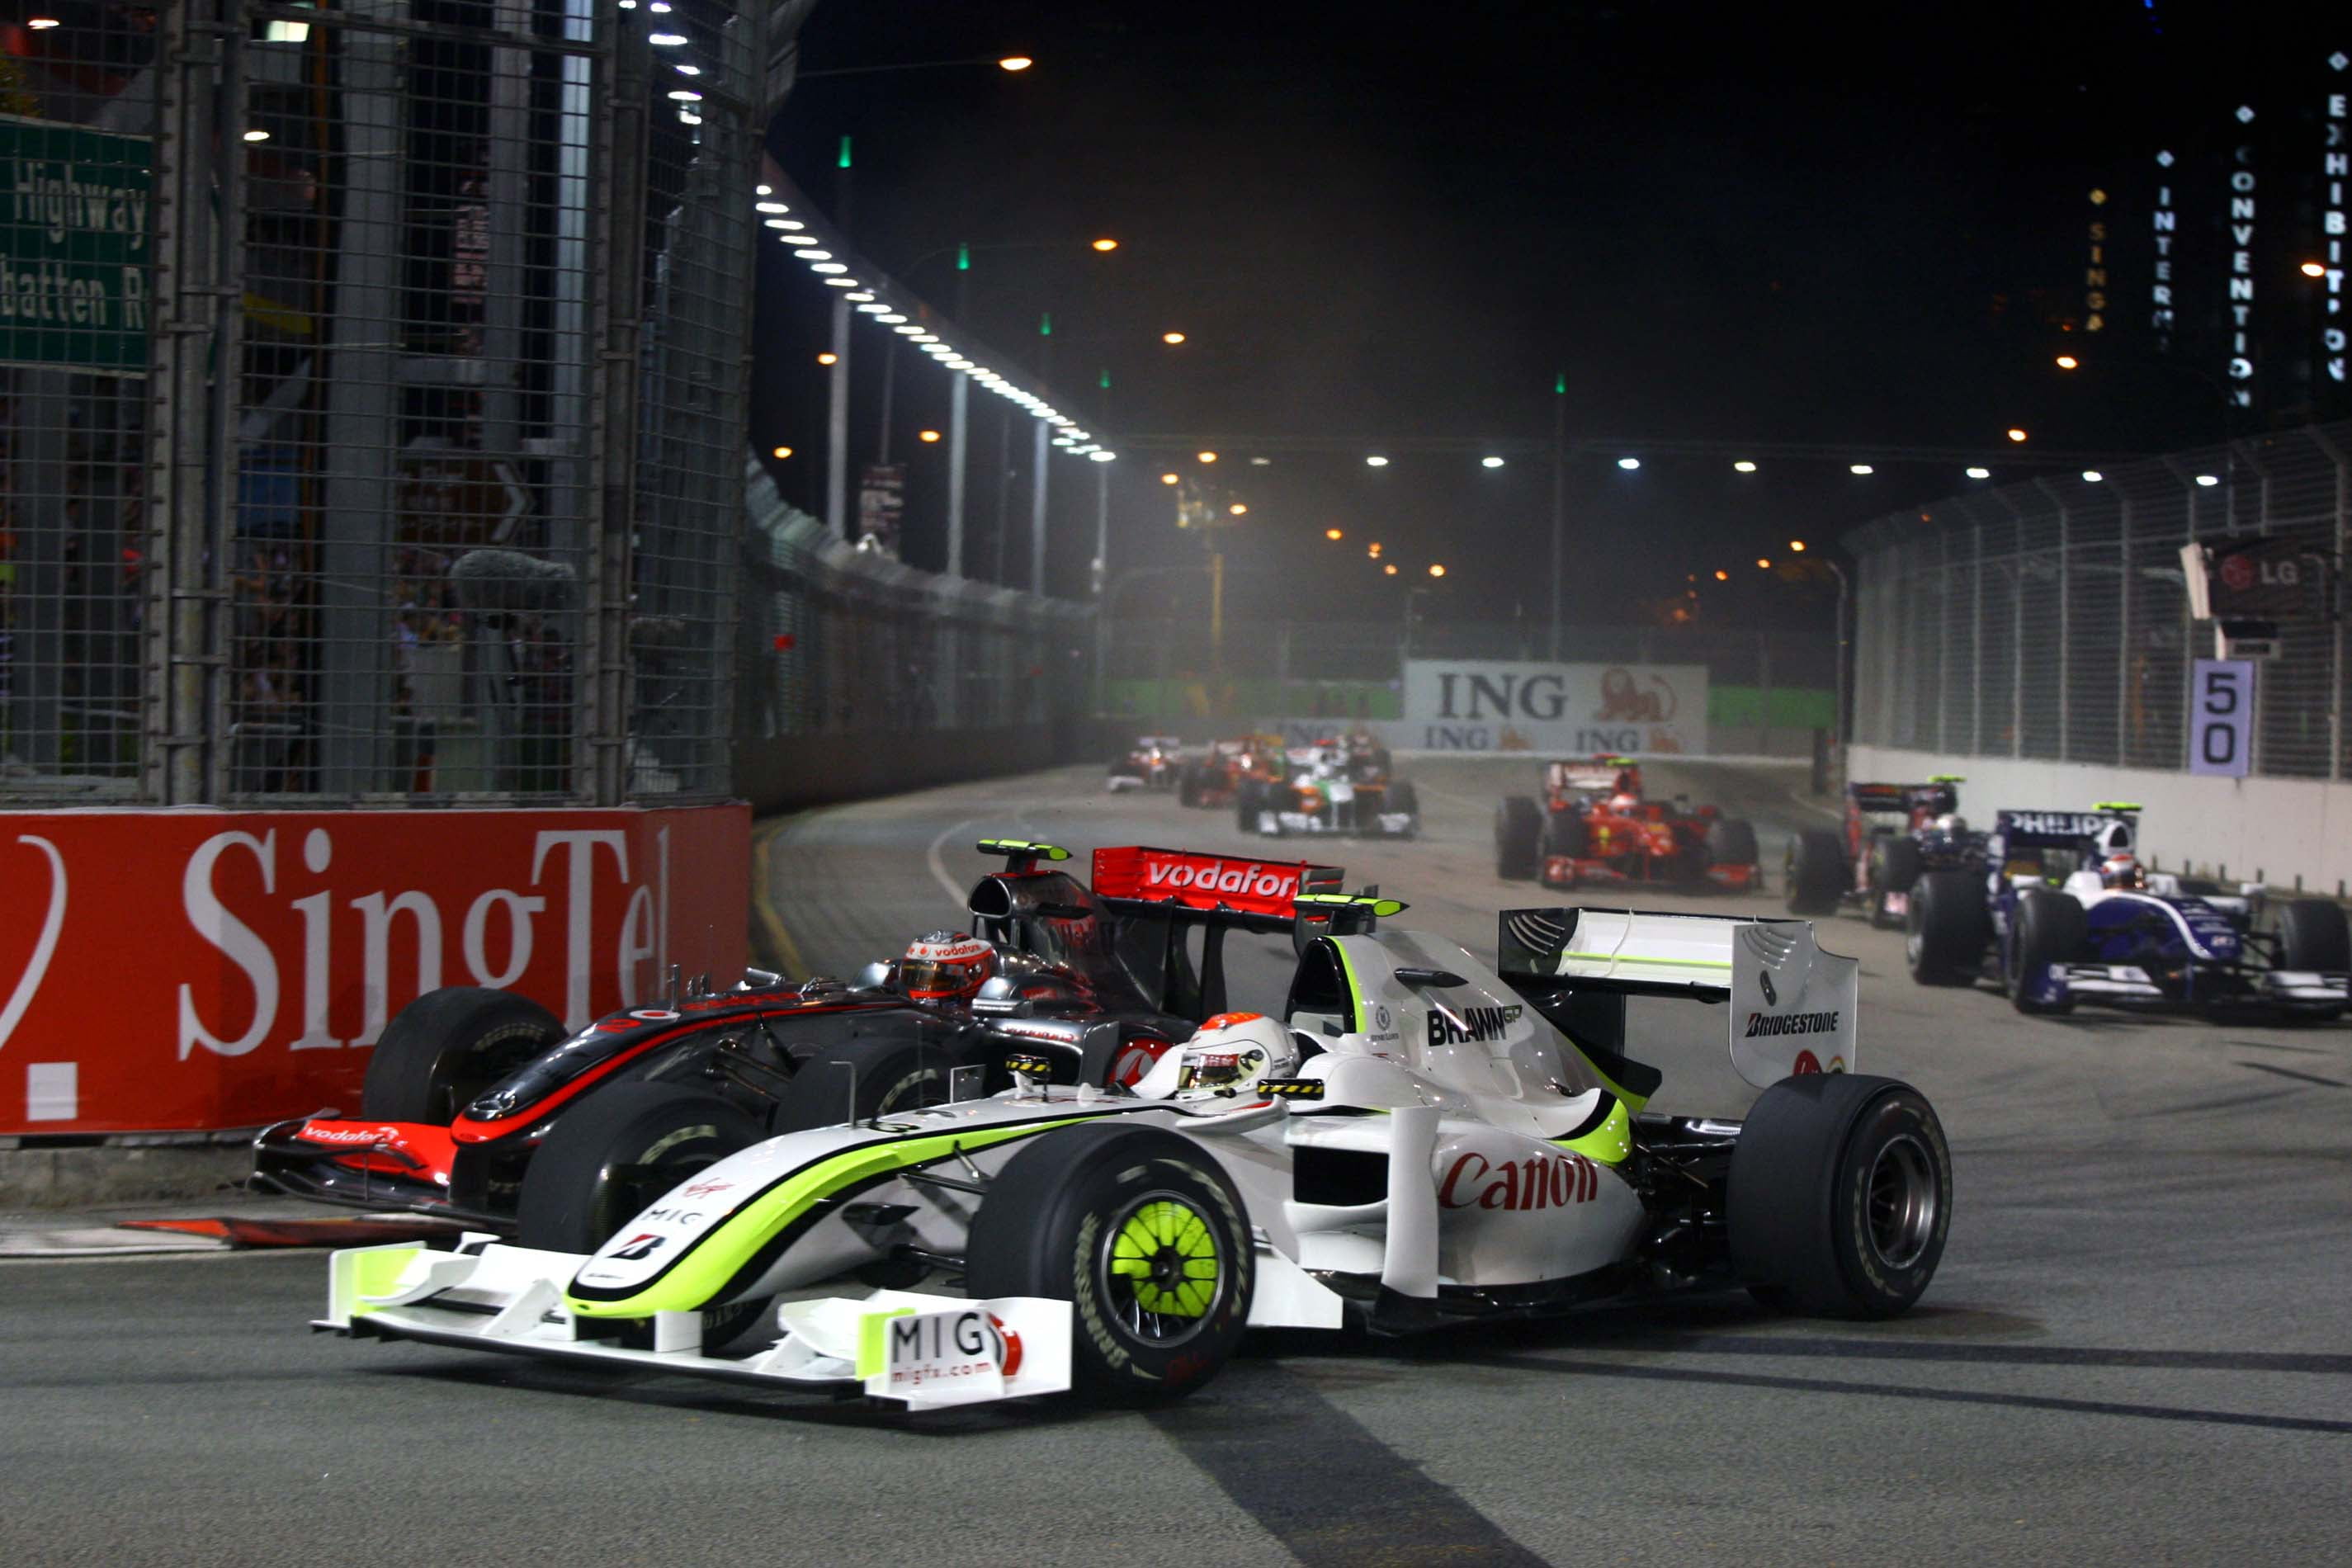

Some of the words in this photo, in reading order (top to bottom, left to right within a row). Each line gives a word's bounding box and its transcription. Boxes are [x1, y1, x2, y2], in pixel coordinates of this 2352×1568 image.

[13, 162, 147, 250] Highway
[122, 265, 150, 329] R
[2260, 560, 2298, 585] LG
[1438, 673, 1568, 721] ING
[2202, 672, 2237, 765] 50
[1424, 725, 1489, 751] ING
[1575, 730, 1639, 753] ING
[2010, 812, 2103, 836] PHILIP
[1149, 860, 1299, 898] vodafon
[178, 828, 670, 1061] SingTel
[1427, 1006, 1507, 1046] BRAWN
[1745, 1011, 1840, 1037] BRIDGESTONE
[1438, 1152, 1598, 1210] Canon
[892, 1311, 985, 1363] MIG
